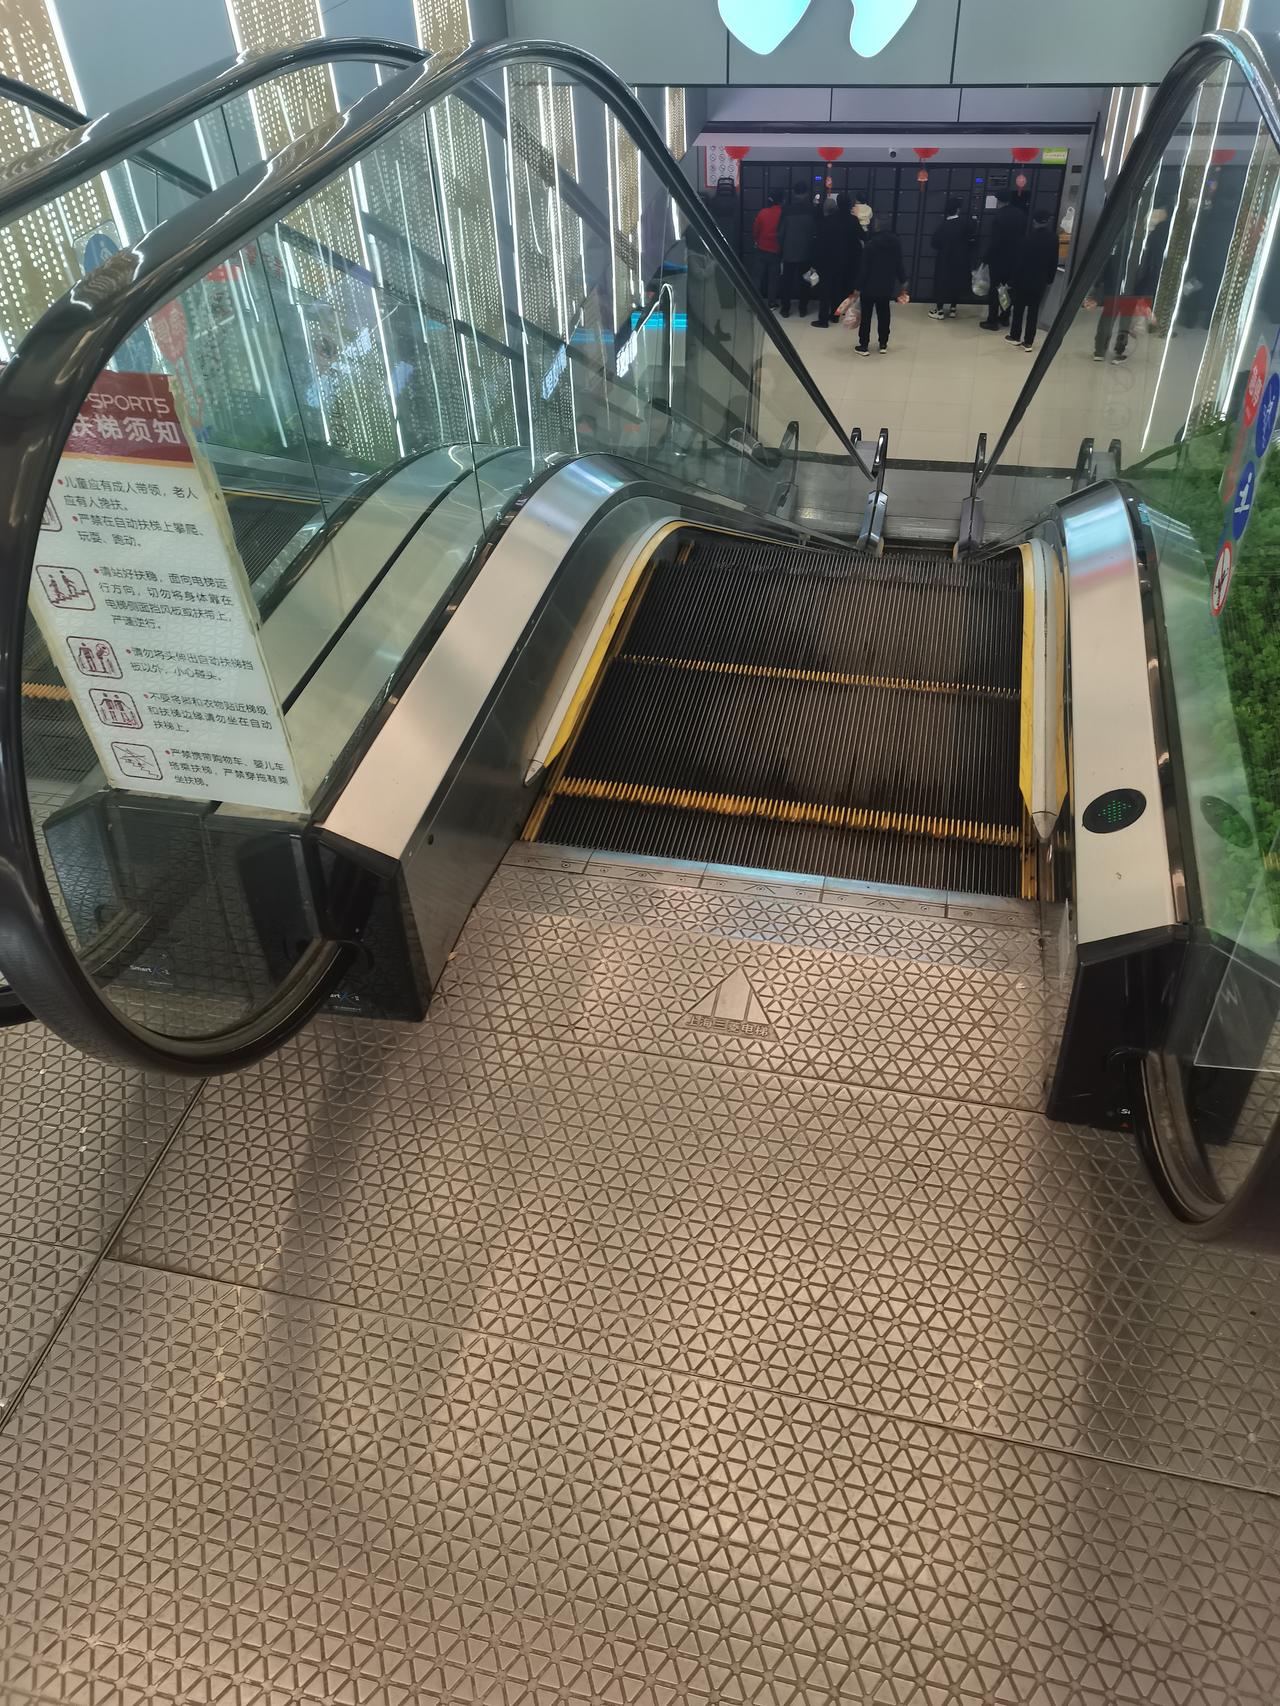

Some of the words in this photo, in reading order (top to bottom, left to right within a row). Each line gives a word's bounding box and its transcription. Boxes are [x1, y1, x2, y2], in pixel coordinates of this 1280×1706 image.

[84, 392, 170, 414] SPORTS
[71, 413, 181, 444] 扶梯须知
[686, 1015, 769, 1037] 上海三菱电梯
